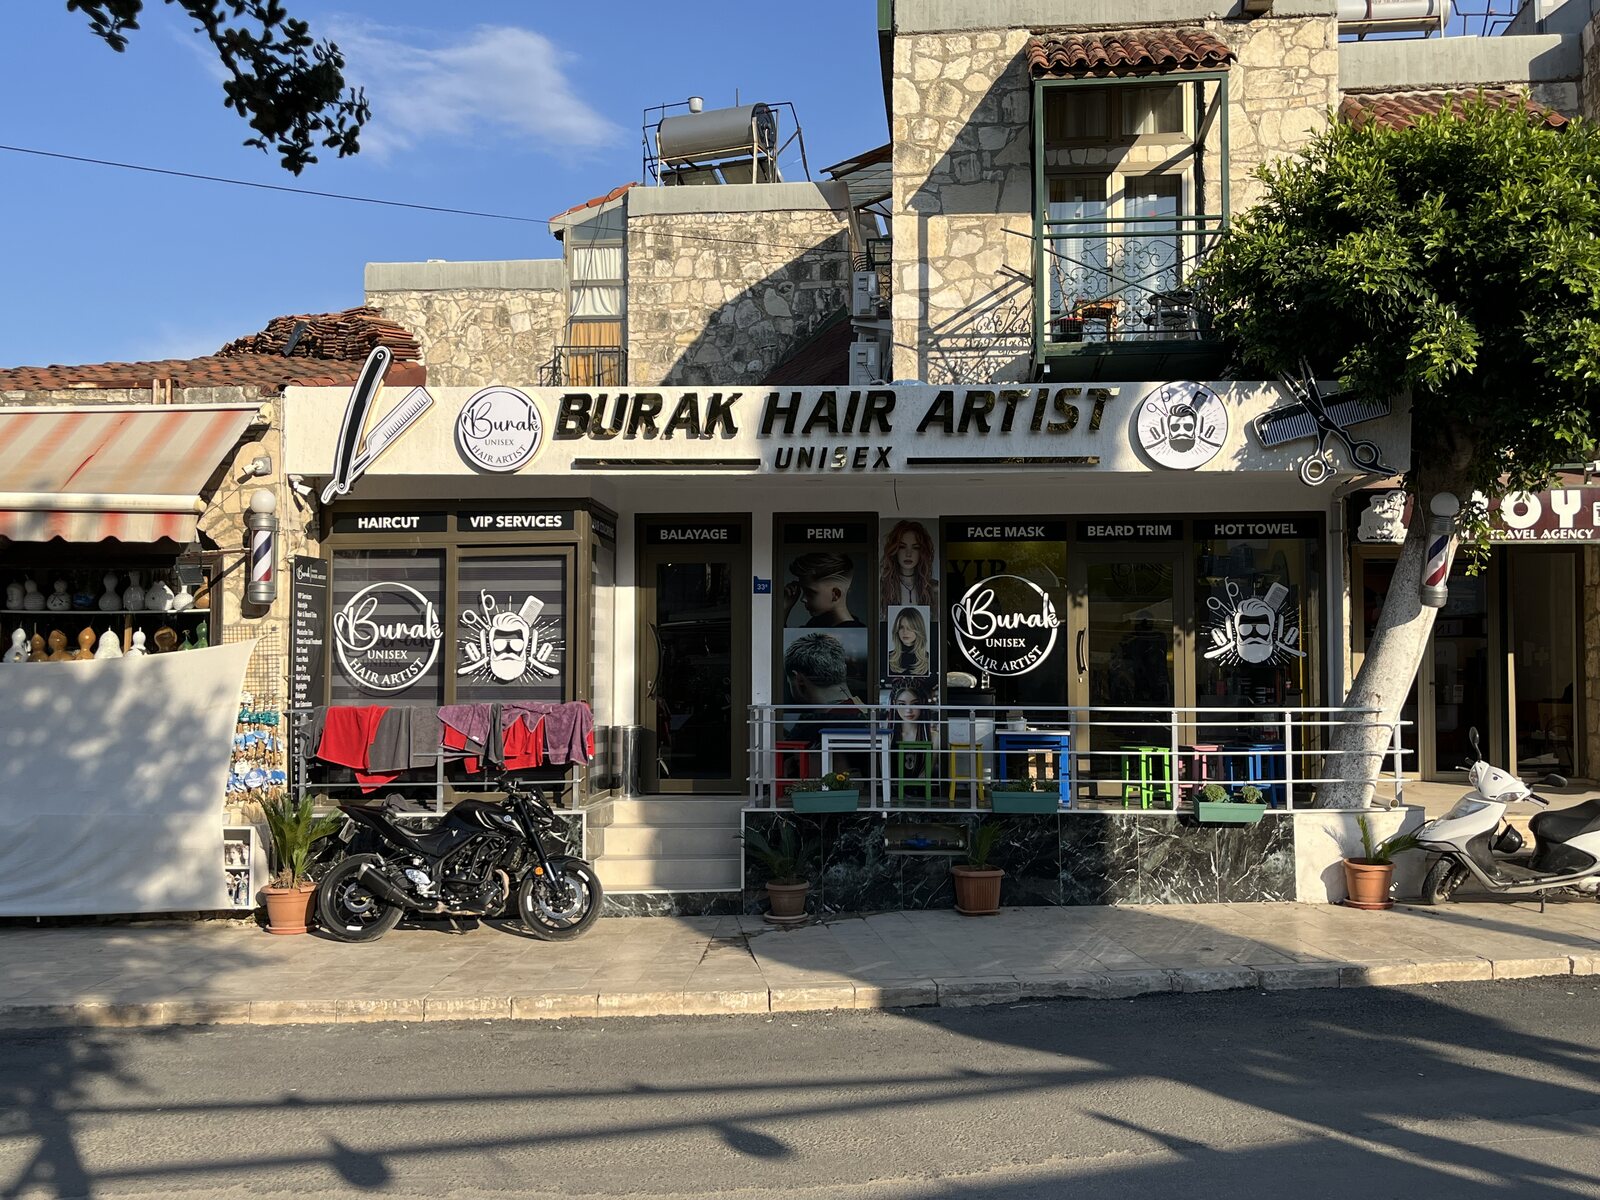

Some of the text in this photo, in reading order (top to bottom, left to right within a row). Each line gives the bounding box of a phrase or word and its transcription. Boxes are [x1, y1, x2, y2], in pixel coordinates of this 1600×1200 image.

[555, 387, 1121, 439] BURAK HAIR ARTIST
[461, 401, 540, 440] Burak
[484, 438, 514, 446] UNISEX
[472, 444, 526, 463] HAIR ARTIST
[774, 446, 893, 470] UNISEX
[357, 516, 420, 529] HAIRCUT
[470, 515, 562, 528] VIP SERVICES
[659, 528, 728, 541] BALAYAGE
[806, 527, 844, 540] PERM
[966, 525, 1046, 538] FACE MASK
[1087, 524, 1172, 537] BEARD TRIM
[1214, 522, 1298, 536] HOT TOWEL
[1489, 529, 1537, 540] TRAVEL
[1540, 528, 1594, 540] AGENCY
[951, 589, 1061, 640] Burak
[333, 597, 443, 651] Burak
[985, 638, 1026, 648] UNISEX
[367, 649, 408, 660] UNISEX
[967, 645, 1043, 671] HAIR ARTIST
[349, 657, 424, 685] HAIR ARTIST
